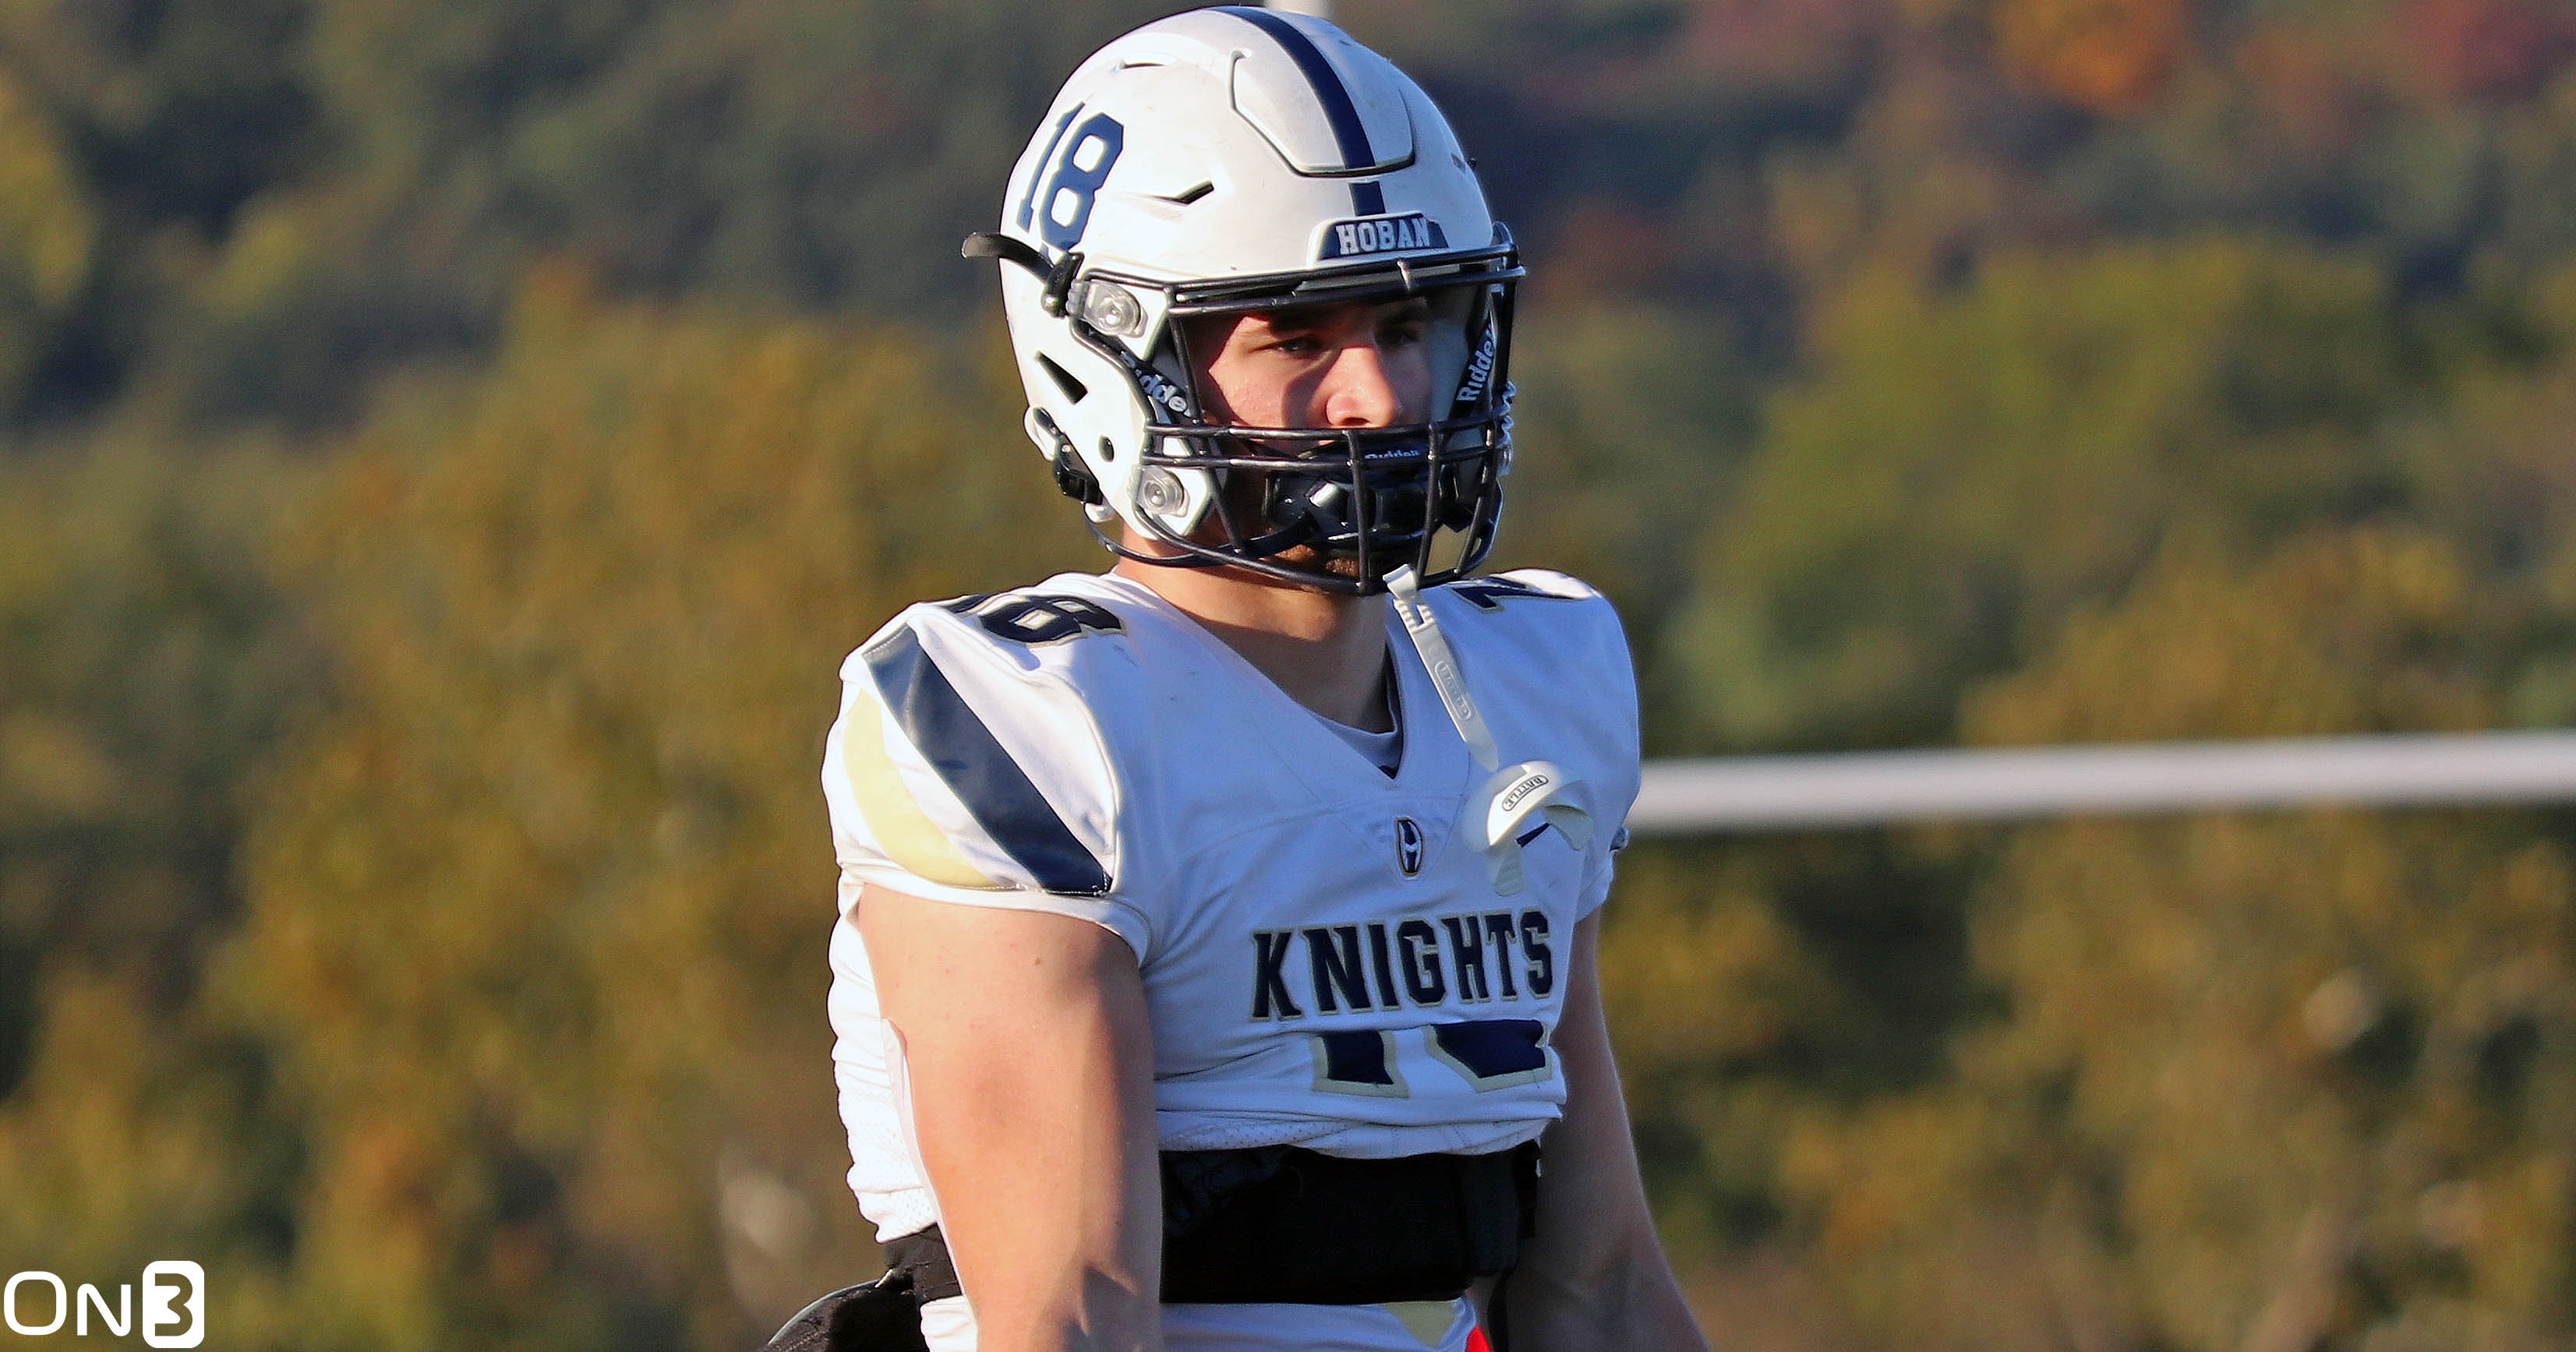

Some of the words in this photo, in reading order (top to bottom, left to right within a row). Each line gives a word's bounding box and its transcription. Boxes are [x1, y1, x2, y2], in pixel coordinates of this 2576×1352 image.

[1016, 101, 1124, 252] 18
[1335, 217, 1430, 255] HOBAN
[1250, 906, 1553, 1022] KNIGHTS
